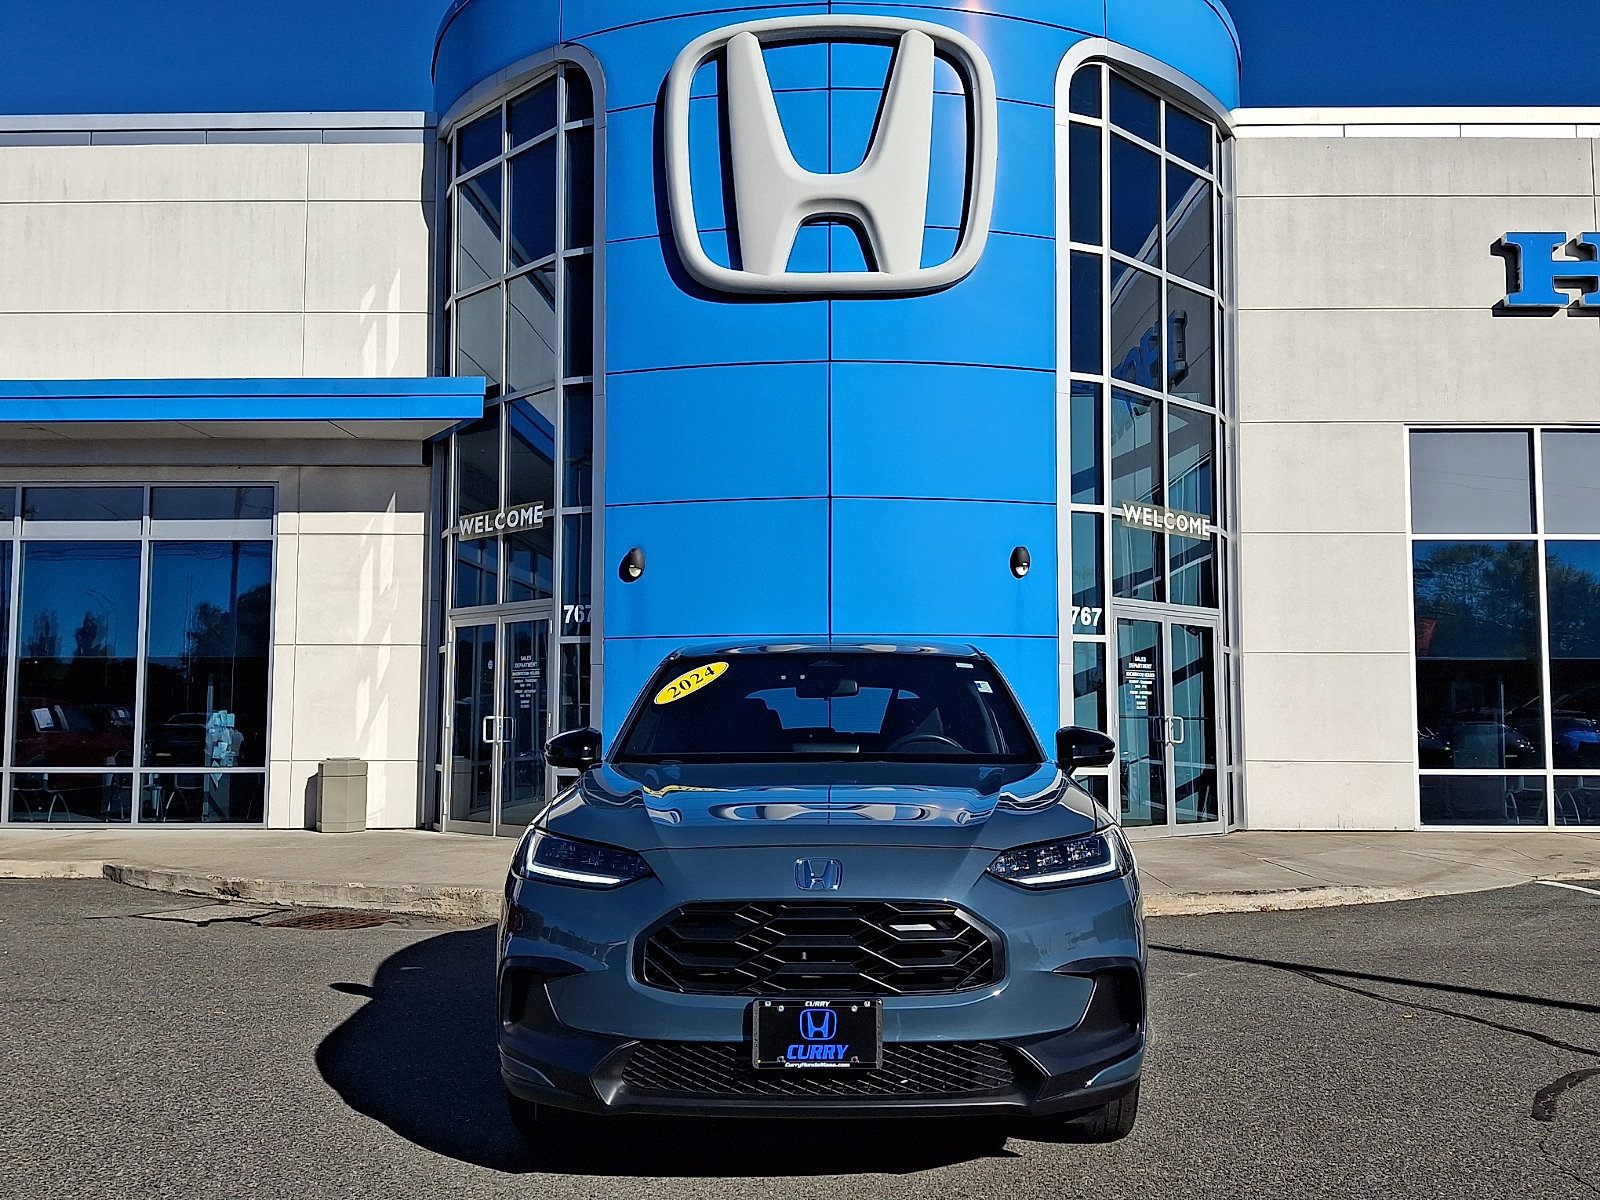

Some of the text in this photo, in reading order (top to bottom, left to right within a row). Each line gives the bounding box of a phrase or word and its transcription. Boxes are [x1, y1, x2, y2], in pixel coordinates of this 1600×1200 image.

[459, 504, 543, 536] WELCOME
[1122, 503, 1211, 537] WELCOME
[1071, 605, 1103, 627] 767
[667, 666, 715, 698] 2024
[786, 1044, 850, 1060] CURRY
